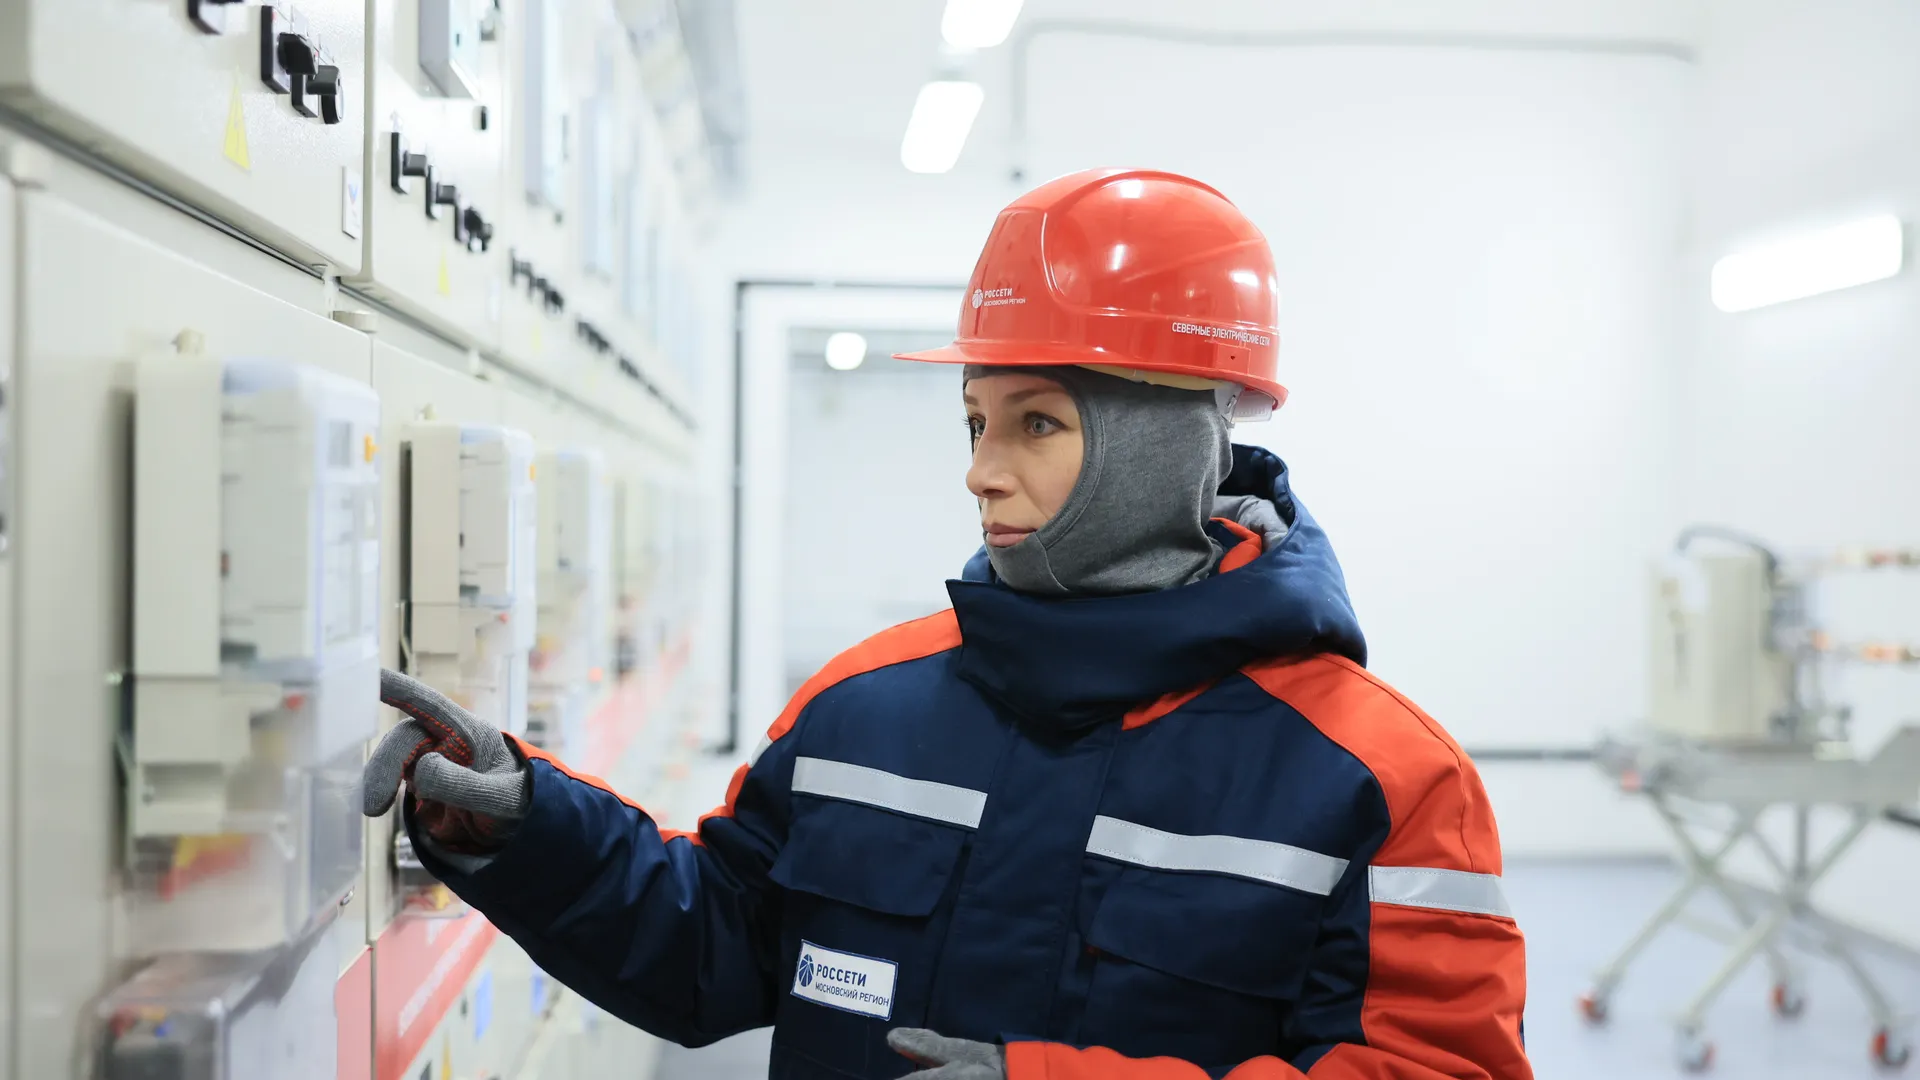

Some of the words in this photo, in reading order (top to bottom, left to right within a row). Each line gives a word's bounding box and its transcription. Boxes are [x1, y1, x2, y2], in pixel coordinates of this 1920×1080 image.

[984, 288, 1012, 298] РОССЕТИ
[1172, 322, 1210, 336] СЕВЕРНЫЕ
[1212, 327, 1259, 345] ЭЛЕКТРИЧЕСКИЕ
[1259, 336, 1270, 346] СЕТИ
[816, 964, 867, 987] РОССЕТИ
[814, 982, 858, 1000] МОСКОВСКИЙ
[859, 992, 890, 1007] РЕГИОН
